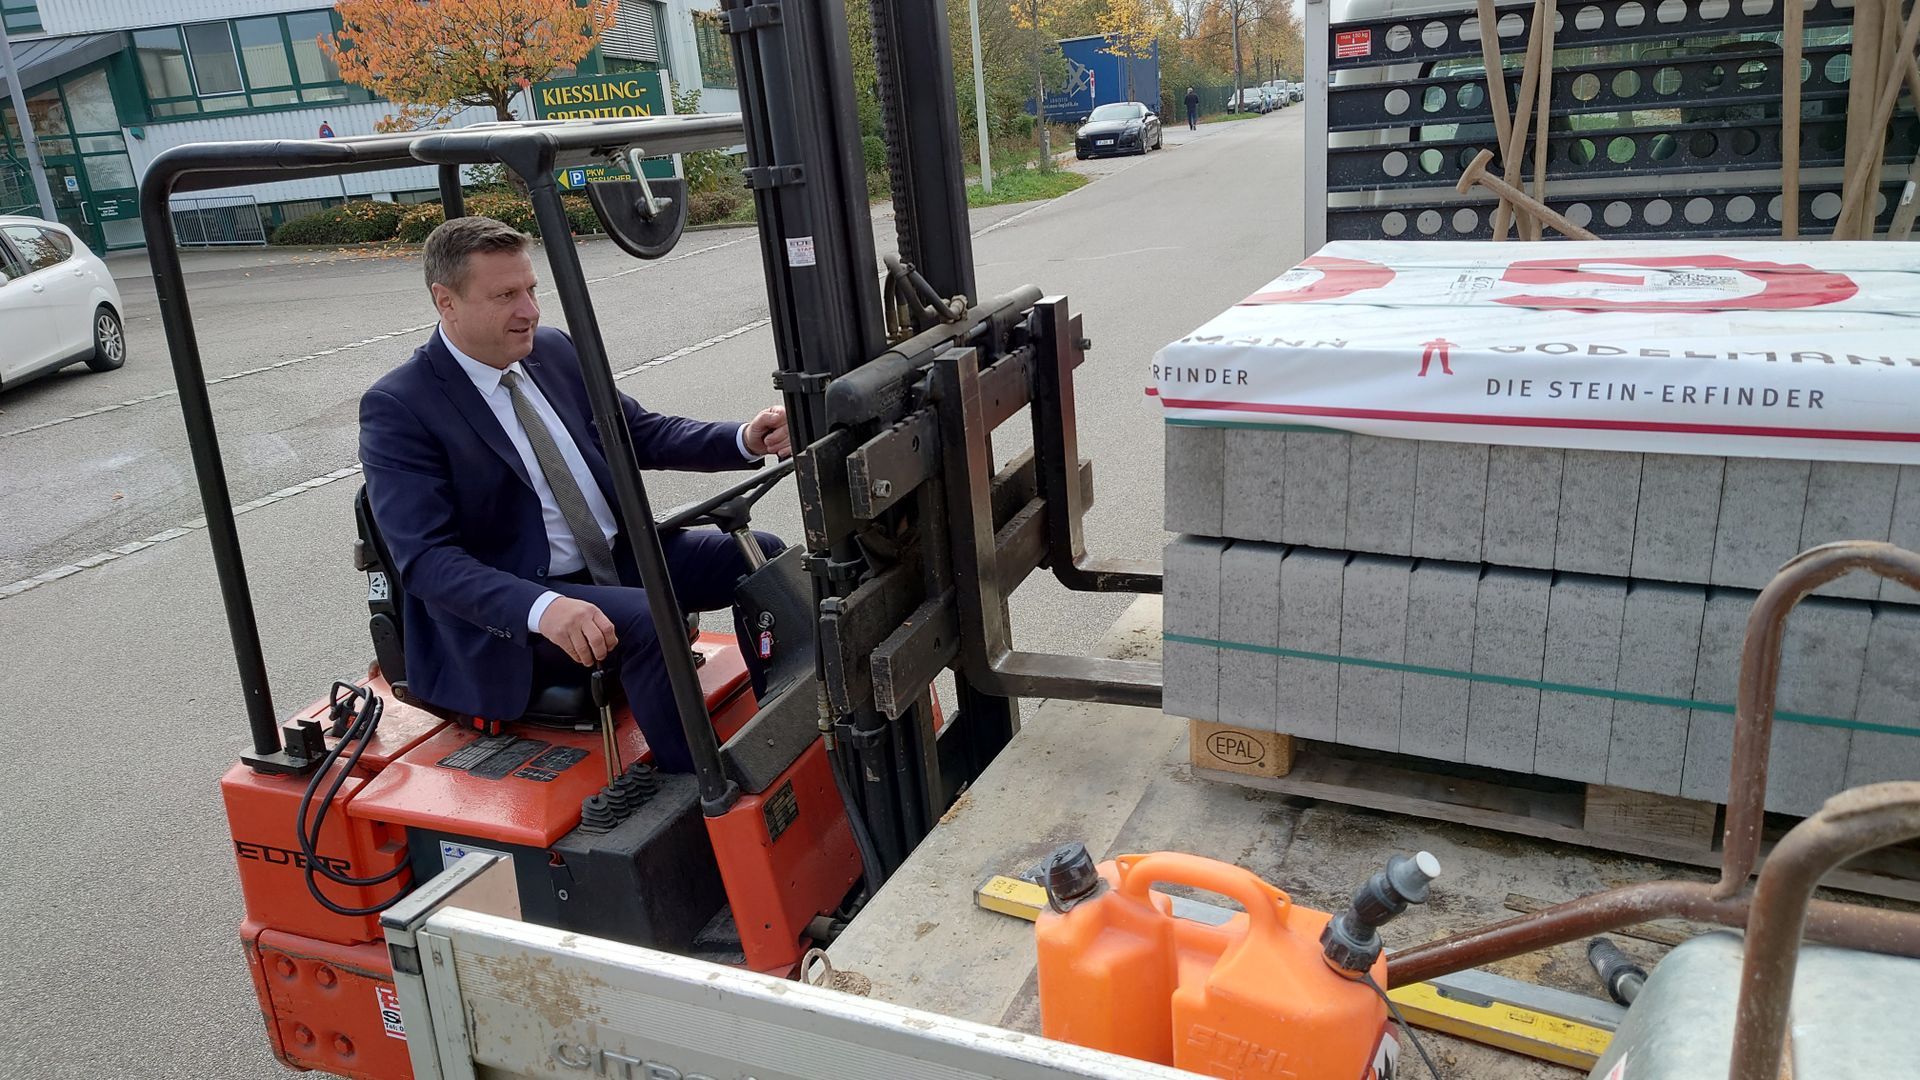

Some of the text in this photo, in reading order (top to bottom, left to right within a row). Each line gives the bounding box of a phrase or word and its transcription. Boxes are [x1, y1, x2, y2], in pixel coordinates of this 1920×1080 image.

[542, 80, 647, 106] KIESSLING-
[586, 168, 605, 177] PKW
[1149, 364, 1249, 386] RFINDER
[1486, 378, 1825, 409] DIE STEIN-ERFINDER
[1216, 736, 1256, 759] EPAL
[234, 840, 351, 878] EDER
[1186, 1023, 1298, 1079] STIHL
